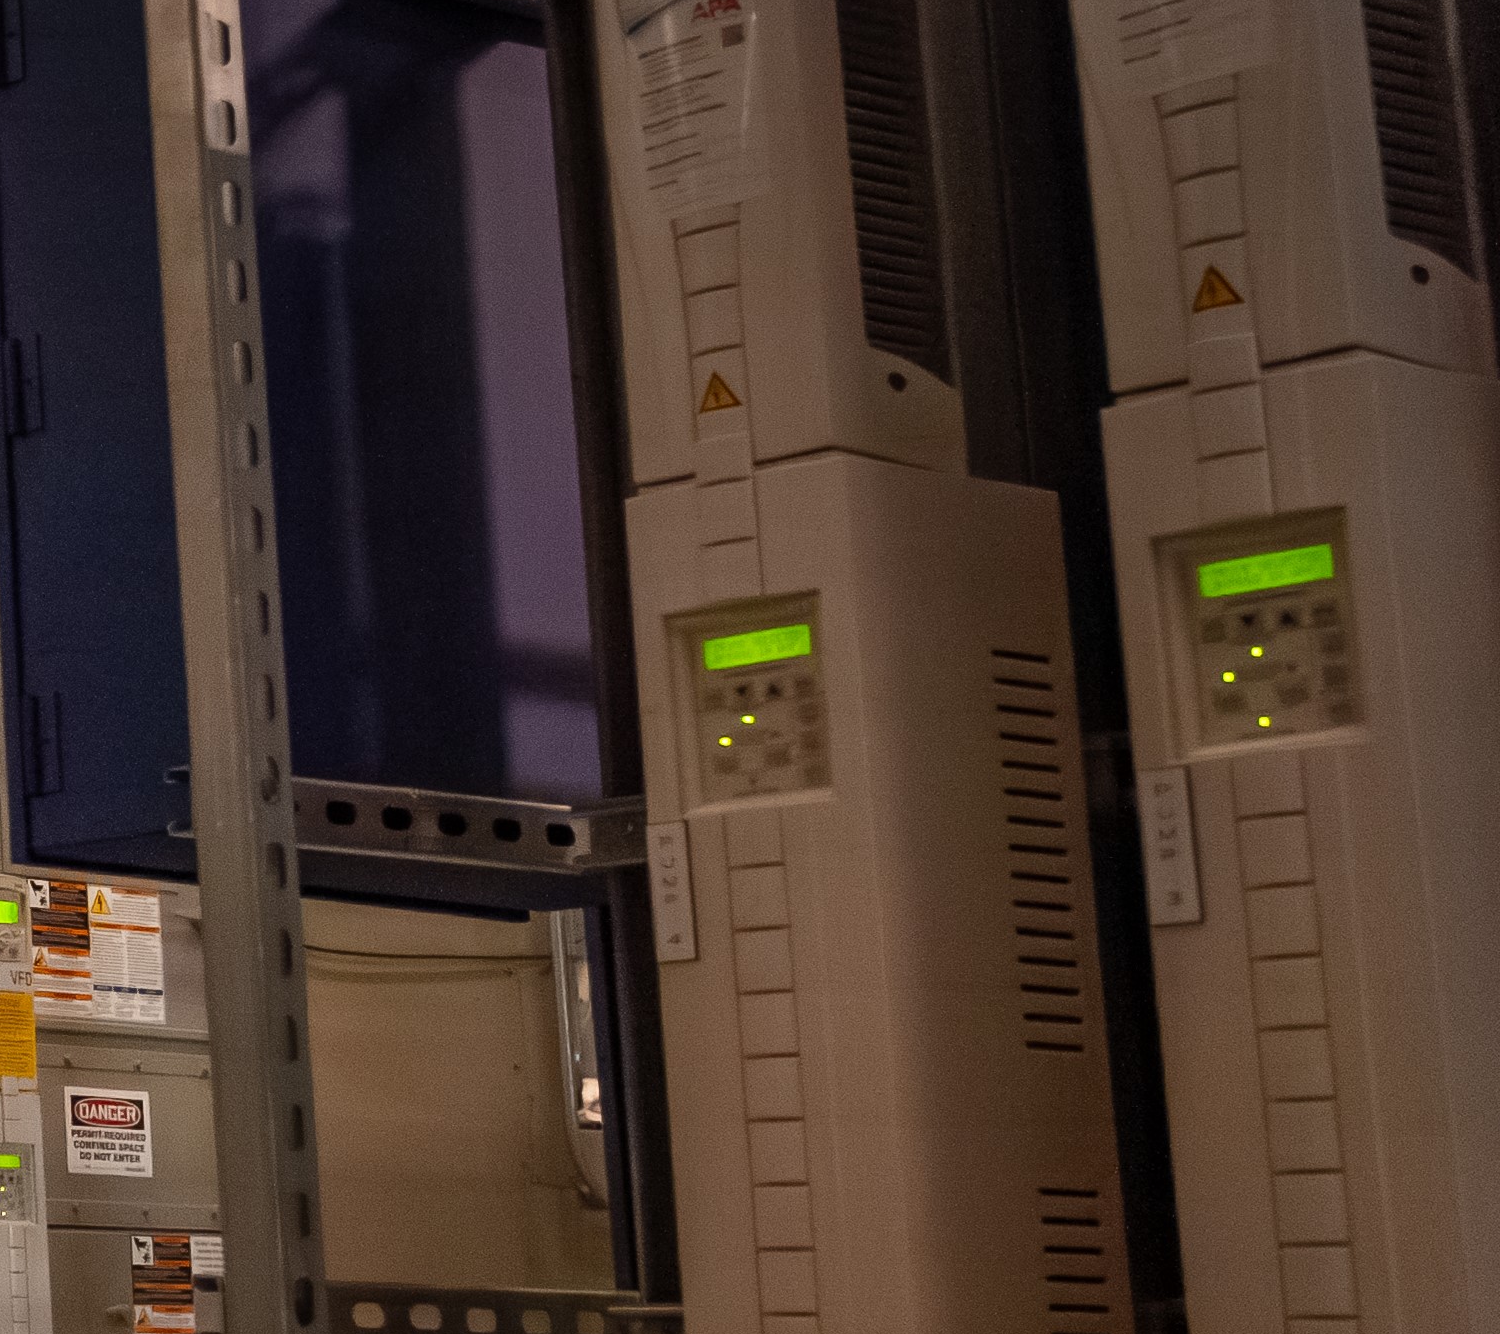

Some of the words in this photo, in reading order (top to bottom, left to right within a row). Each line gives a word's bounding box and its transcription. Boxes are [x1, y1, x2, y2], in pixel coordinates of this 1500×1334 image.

[10, 970, 33, 986] VFD
[80, 1103, 136, 1122] DANGER
[74, 1140, 116, 1151] CONFINED
[94, 1152, 111, 1161] NOT
[113, 1154, 141, 1163] ENTER
